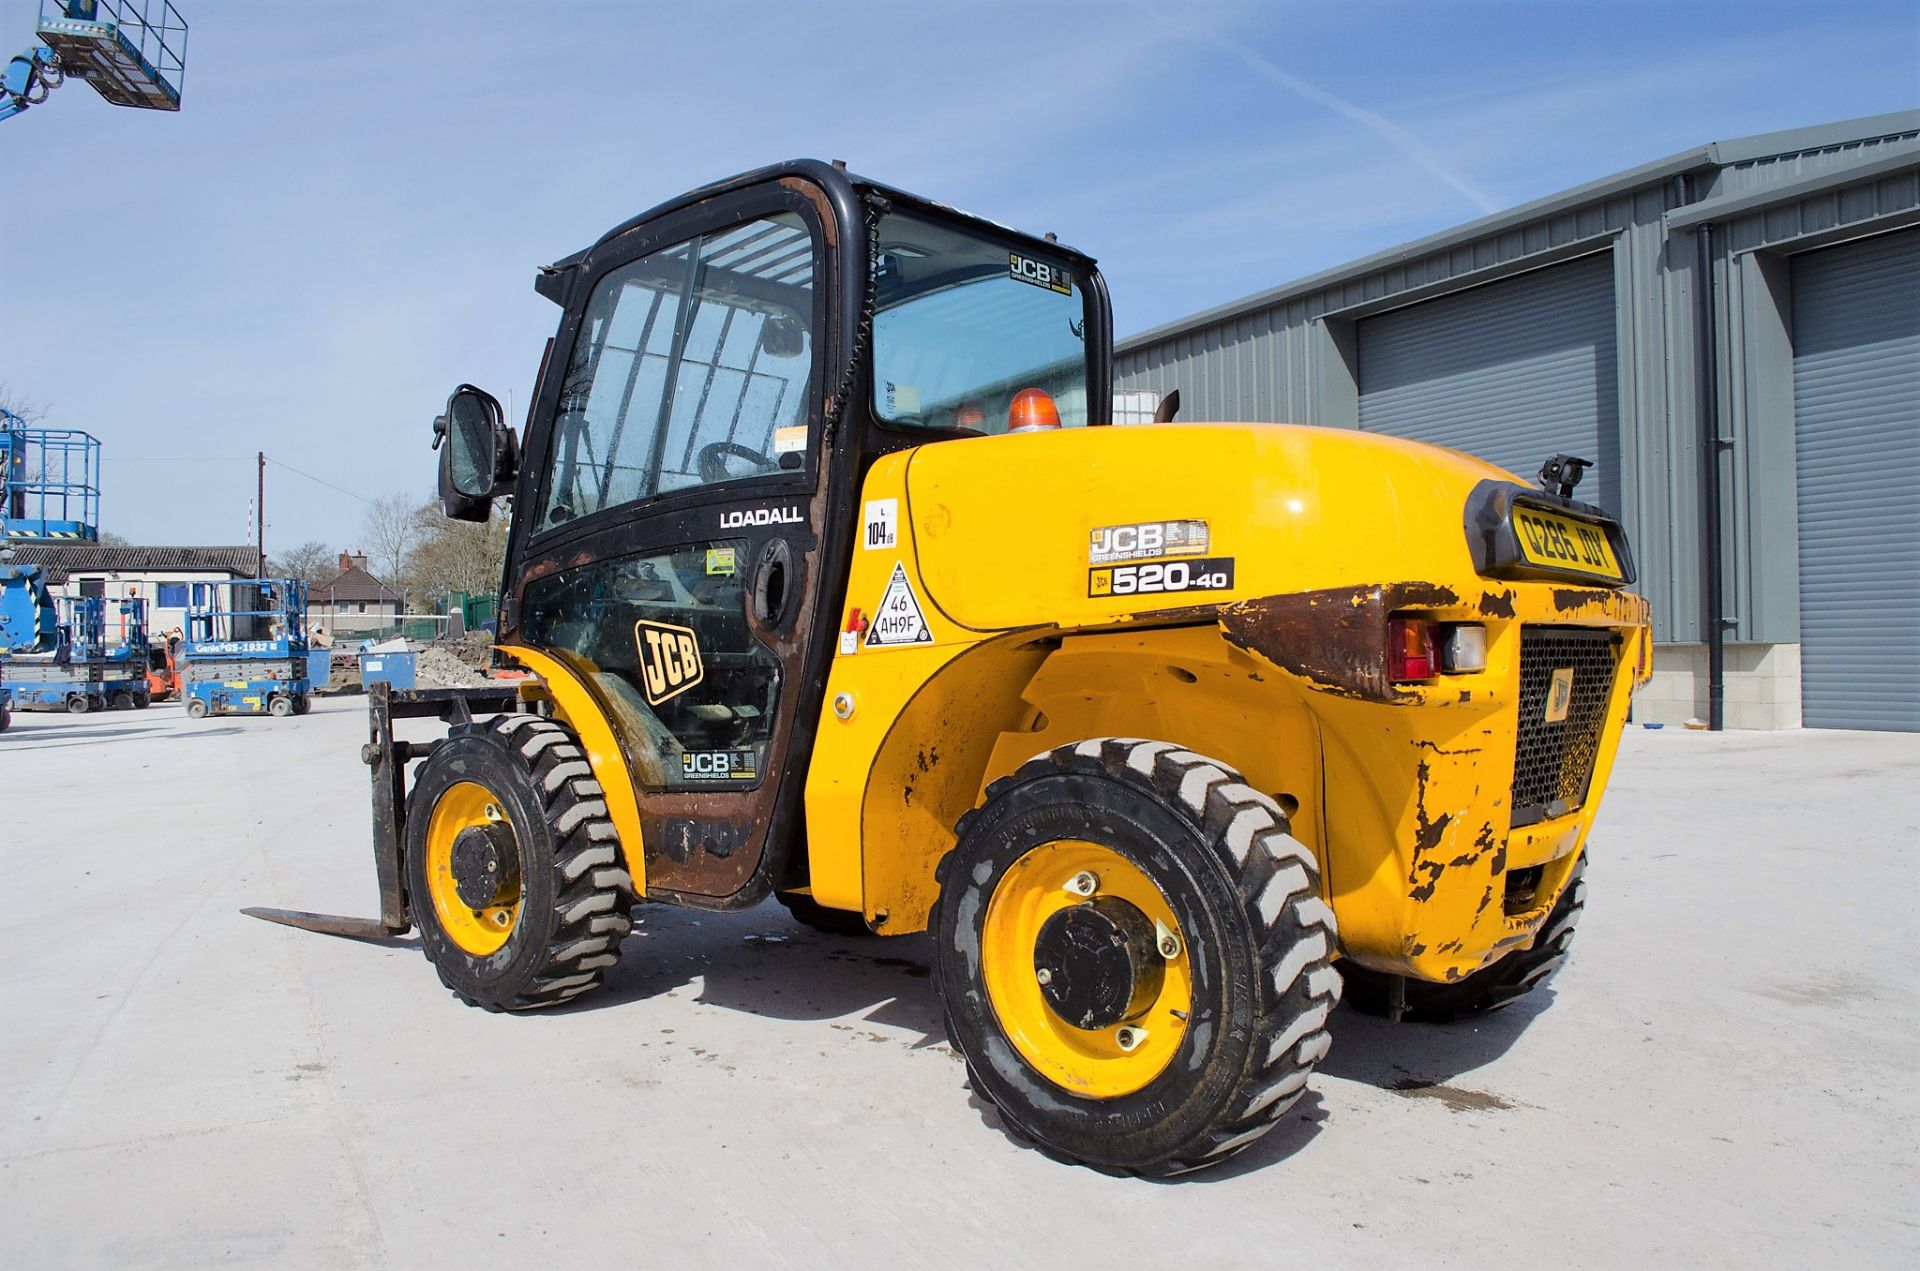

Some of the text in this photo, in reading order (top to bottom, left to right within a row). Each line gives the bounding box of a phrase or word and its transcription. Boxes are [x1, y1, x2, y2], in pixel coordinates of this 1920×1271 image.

[1010, 256, 1050, 282] JCB
[1010, 272, 1051, 289] GREENSHIELDS
[720, 506, 804, 529] LOADALL
[880, 508, 886, 516] L
[868, 521, 886, 545] 104
[1092, 524, 1163, 554] JCB
[1520, 514, 1610, 569] Q286 JDY
[1091, 548, 1162, 562] GREENSHIELDS
[1113, 562, 1227, 594] 520-40
[890, 595, 908, 612] 46
[881, 615, 916, 634] AH9F
[195, 642, 268, 653] Genie GS-1932
[645, 629, 698, 695] JCB
[683, 753, 730, 773] JCB
